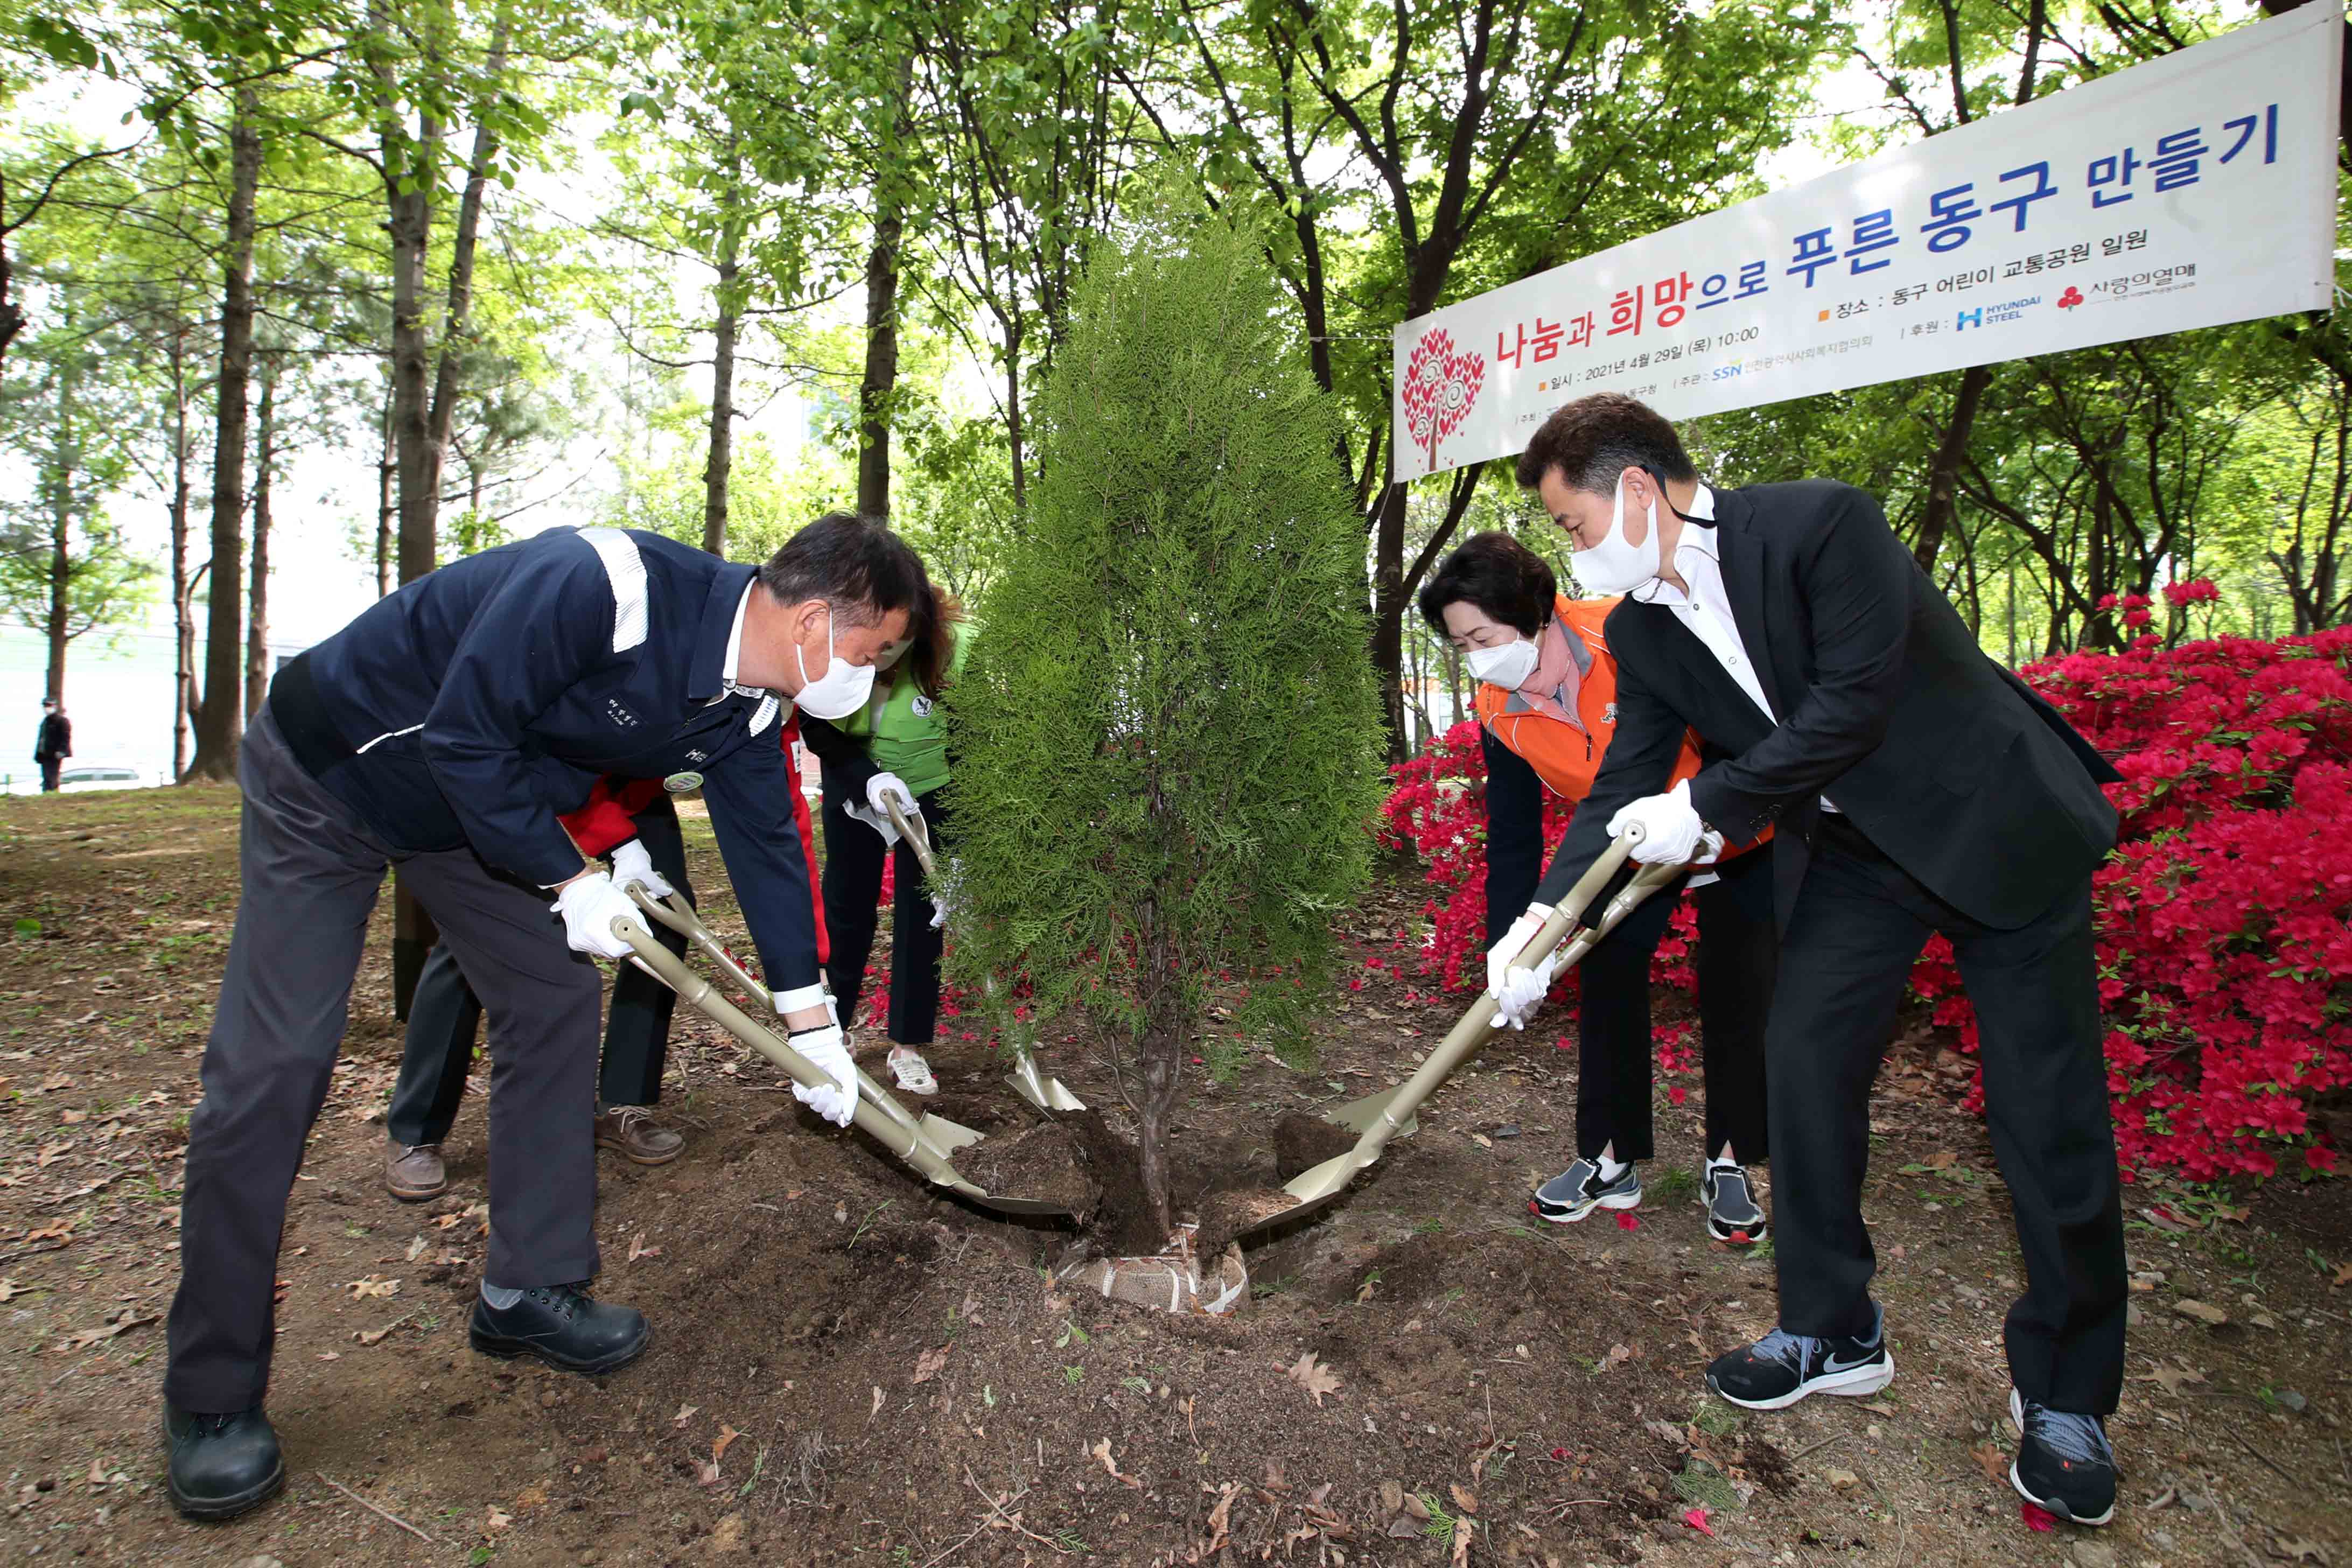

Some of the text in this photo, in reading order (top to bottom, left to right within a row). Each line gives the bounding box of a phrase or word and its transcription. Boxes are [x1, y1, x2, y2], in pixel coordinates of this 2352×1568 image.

[1496, 103, 2278, 369] 나눔과 희망으로 푸른 동구 만들기
[1836, 299, 1870, 320] 장소
[1891, 283, 1929, 305] 동구
[1936, 265, 1995, 293] 어린이
[2003, 242, 2091, 278] 교통공원
[2101, 229, 2148, 257] 일원
[2089, 263, 2196, 295] 사랑의열매
[1910, 320, 1940, 336] 후원
[1986, 296, 2041, 314] HYUNDAI
[1986, 310, 2023, 324] STEEL
[1550, 374, 1572, 390] 일시
[1585, 360, 1626, 381] 2021년
[1630, 353, 1650, 368] 4월
[1654, 345, 1683, 363] 29일
[1688, 337, 1711, 356] (목)
[1718, 326, 1760, 347] 10:00
[1712, 363, 1742, 381] SSN
